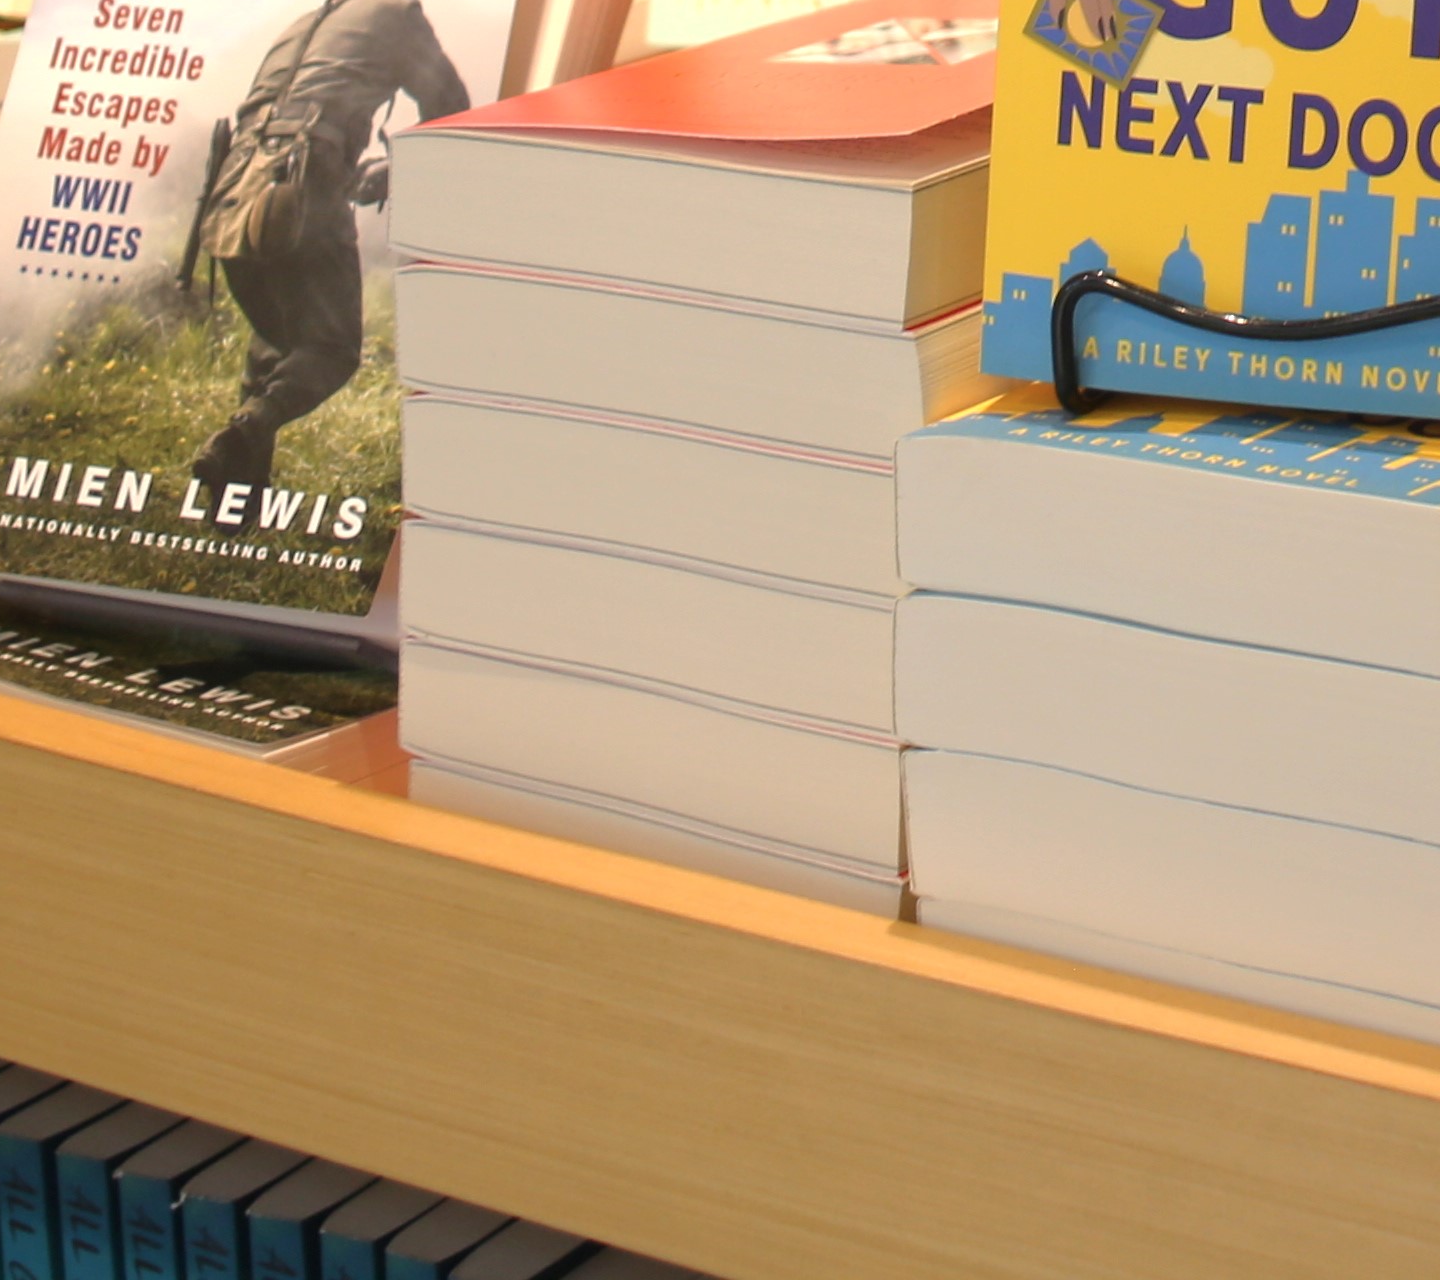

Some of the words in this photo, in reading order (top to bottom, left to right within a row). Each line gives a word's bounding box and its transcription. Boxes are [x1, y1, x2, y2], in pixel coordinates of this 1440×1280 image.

[49, 35, 206, 84] Incredible
[52, 80, 179, 128] Escapes
[1055, 70, 1265, 165] NEXT
[36, 126, 124, 168] Made
[131, 133, 170, 178] by
[50, 172, 133, 217] WWII
[15, 214, 143, 263] HEROES
[1082, 336, 1099, 359] A
[1116, 339, 1213, 372] RILEY
[1228, 351, 1344, 385] THORN
[1037, 428, 1131, 449] RILEY
[1139, 443, 1248, 469] THORN
[1256, 463, 1359, 488] NOVEL
[179, 476, 369, 542] LEWIS
[129, 530, 269, 562] BESTSELLING
[278, 549, 363, 573] AUTHOR
[125, 667, 314, 723] LEWIS
